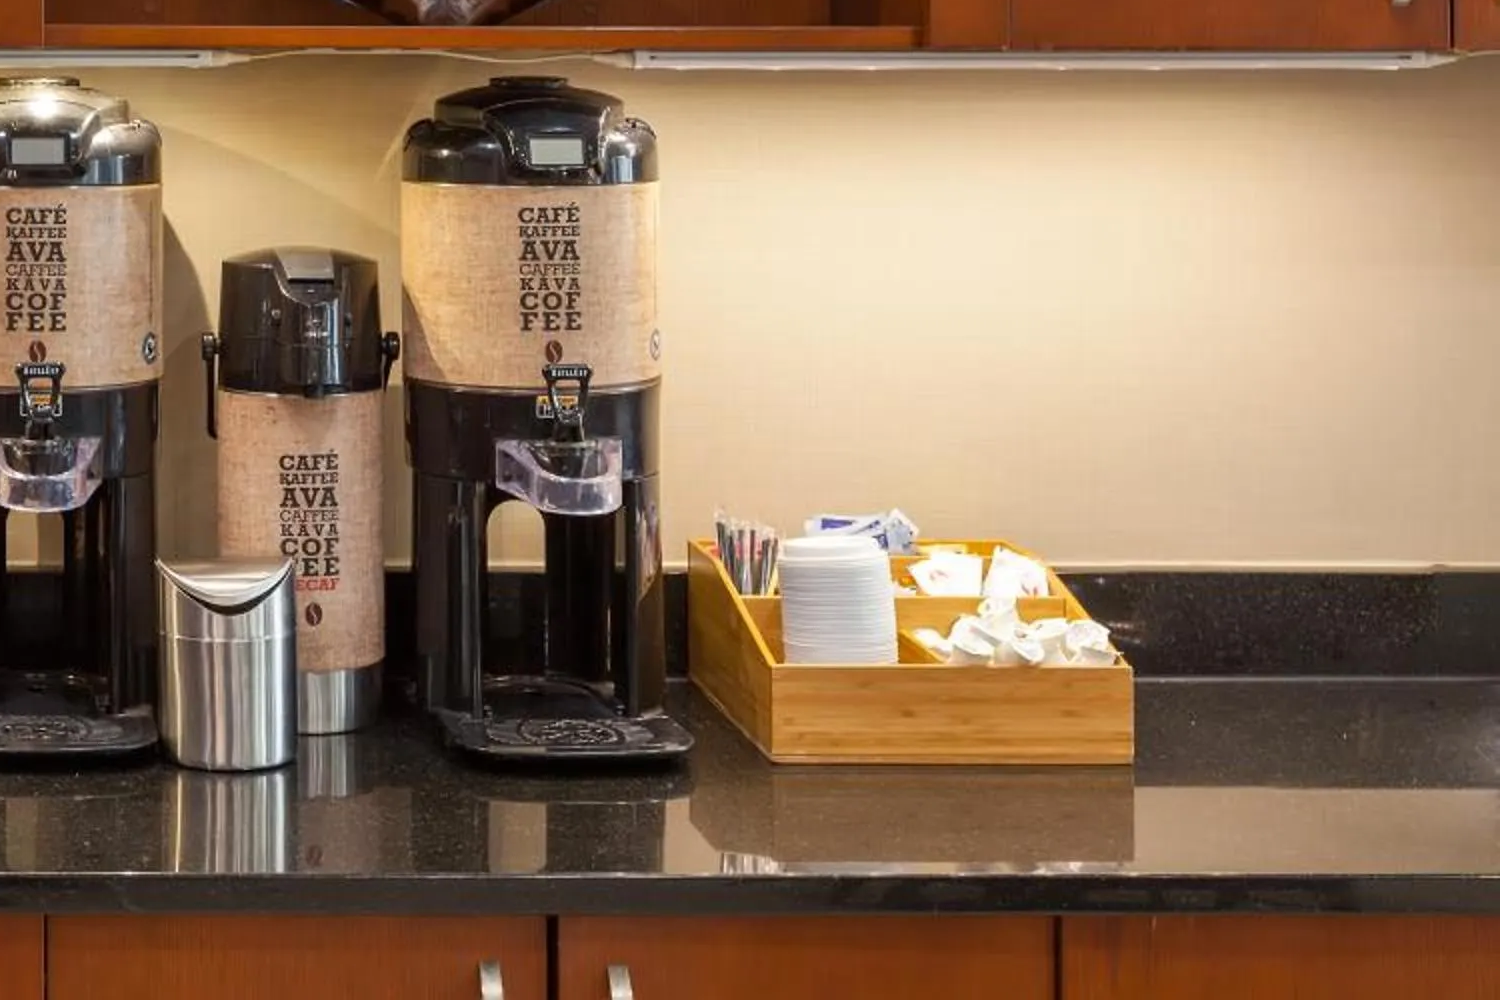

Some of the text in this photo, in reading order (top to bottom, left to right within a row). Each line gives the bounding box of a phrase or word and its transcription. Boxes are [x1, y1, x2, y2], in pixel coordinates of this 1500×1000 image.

[5, 203, 67, 225] CAFÉ
[518, 201, 580, 223] CAFÉ
[5, 226, 67, 240] KAFFEE
[518, 225, 580, 238] KAFFEE
[6, 241, 67, 262] AVA
[519, 240, 580, 261] AVA
[6, 263, 67, 277] CAFFEE
[520, 263, 580, 277] CAFFEE
[6, 278, 67, 291] KAVA
[520, 277, 580, 291] KAVA
[6, 292, 67, 311] COF
[520, 292, 580, 311] COF
[6, 311, 67, 332] FEE
[520, 311, 581, 331] FEE
[279, 449, 338, 471] CAFÉ
[279, 472, 338, 486] KAFFEE
[280, 487, 338, 508] AVA
[280, 509, 338, 523] CAFFEE
[280, 523, 338, 537] KAVA
[280, 538, 339, 556] COF
[294, 557, 340, 577] EE
[295, 578, 340, 591] ECAF
